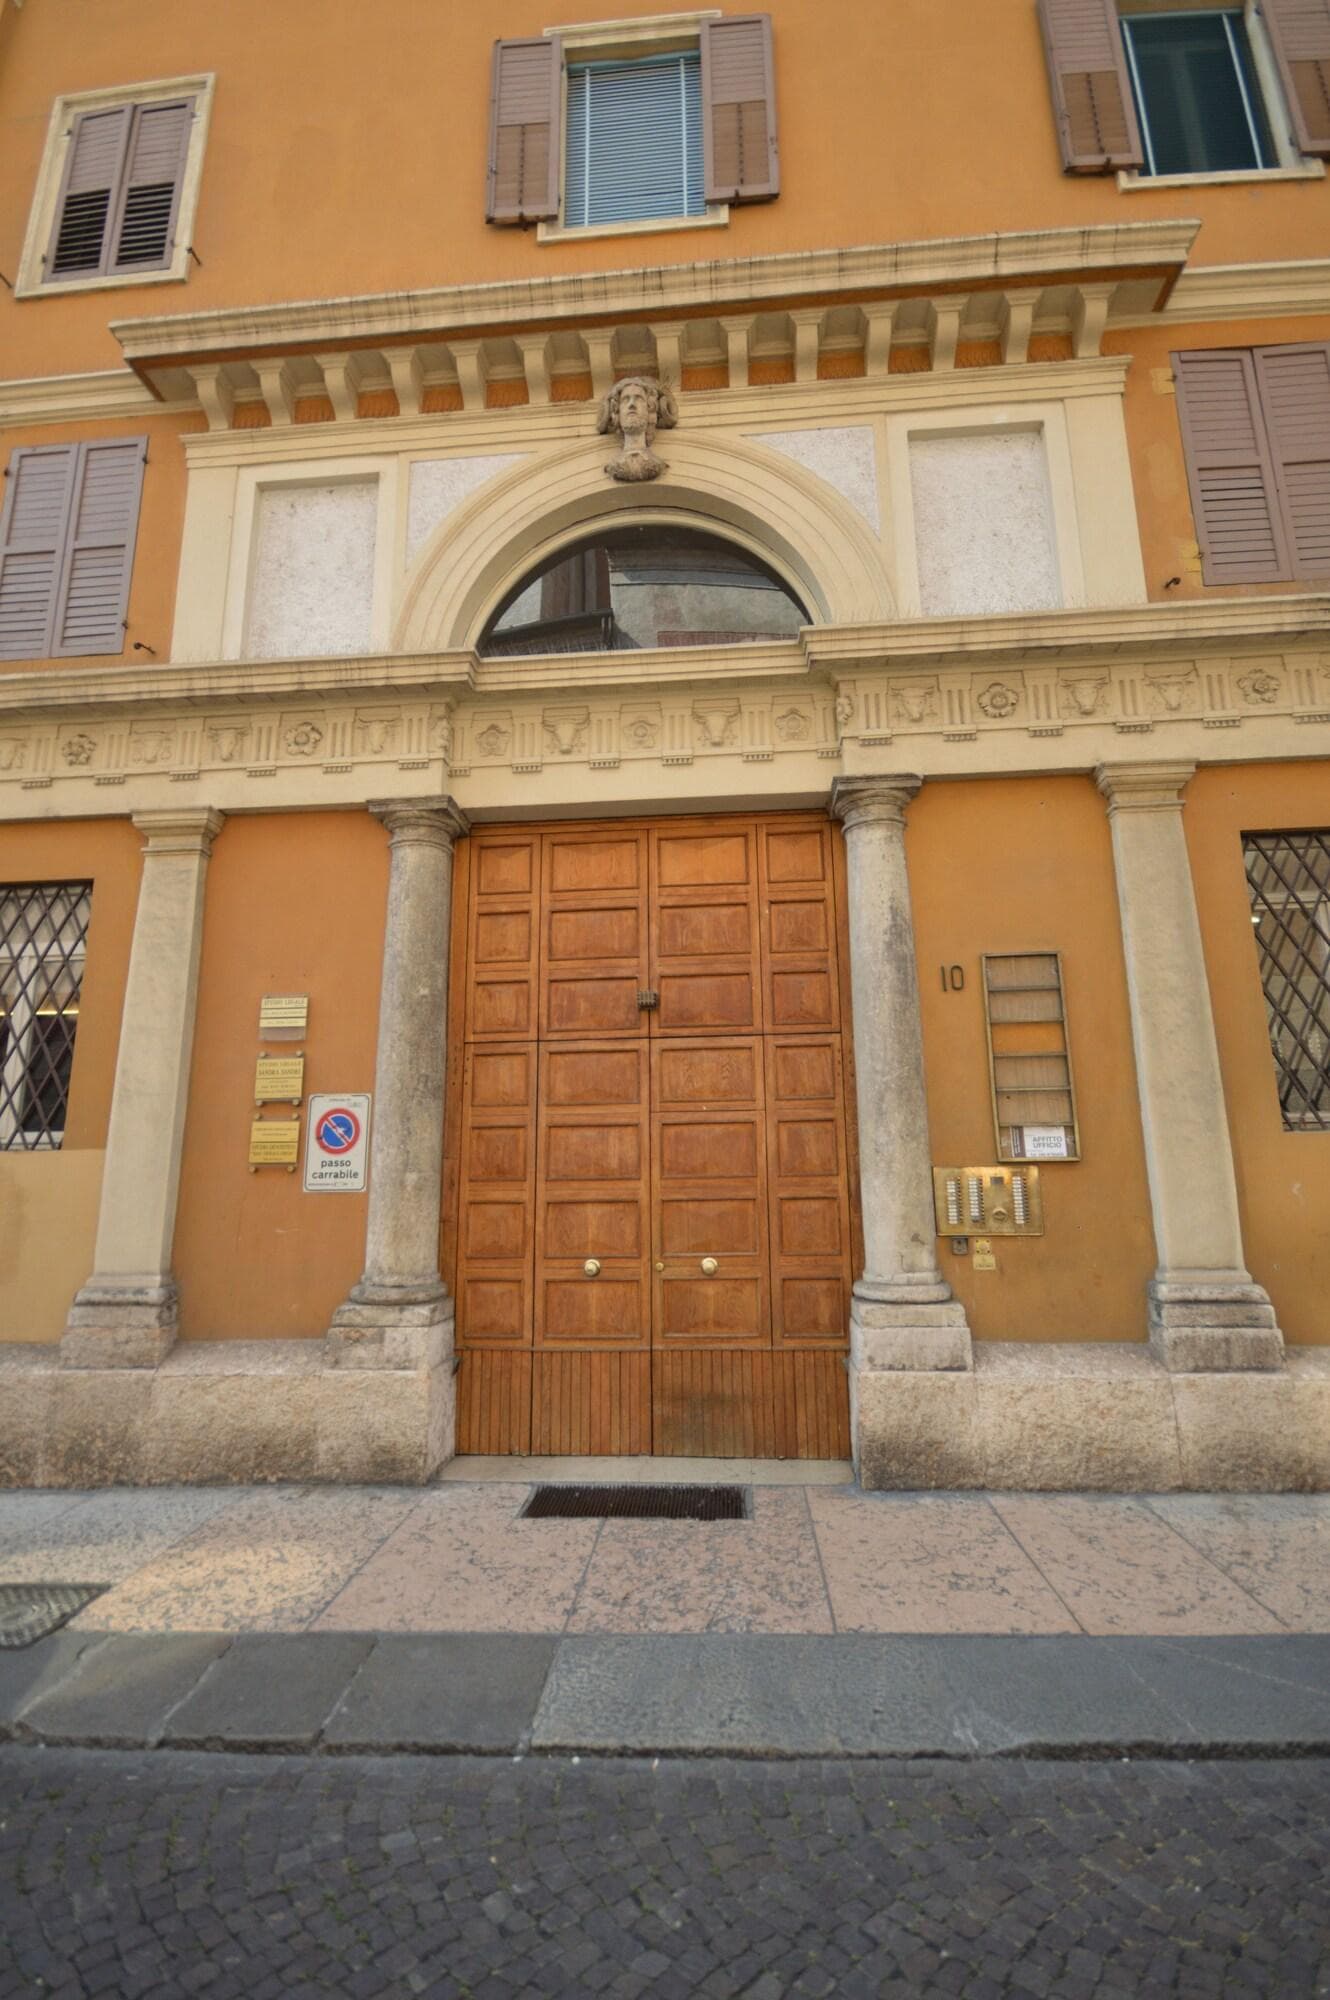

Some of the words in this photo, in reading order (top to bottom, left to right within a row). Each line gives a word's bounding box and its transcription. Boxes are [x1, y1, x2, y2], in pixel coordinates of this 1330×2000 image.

[940, 965, 964, 992] 10
[321, 1159, 351, 1168] passo
[312, 1170, 359, 1179] carrabile
